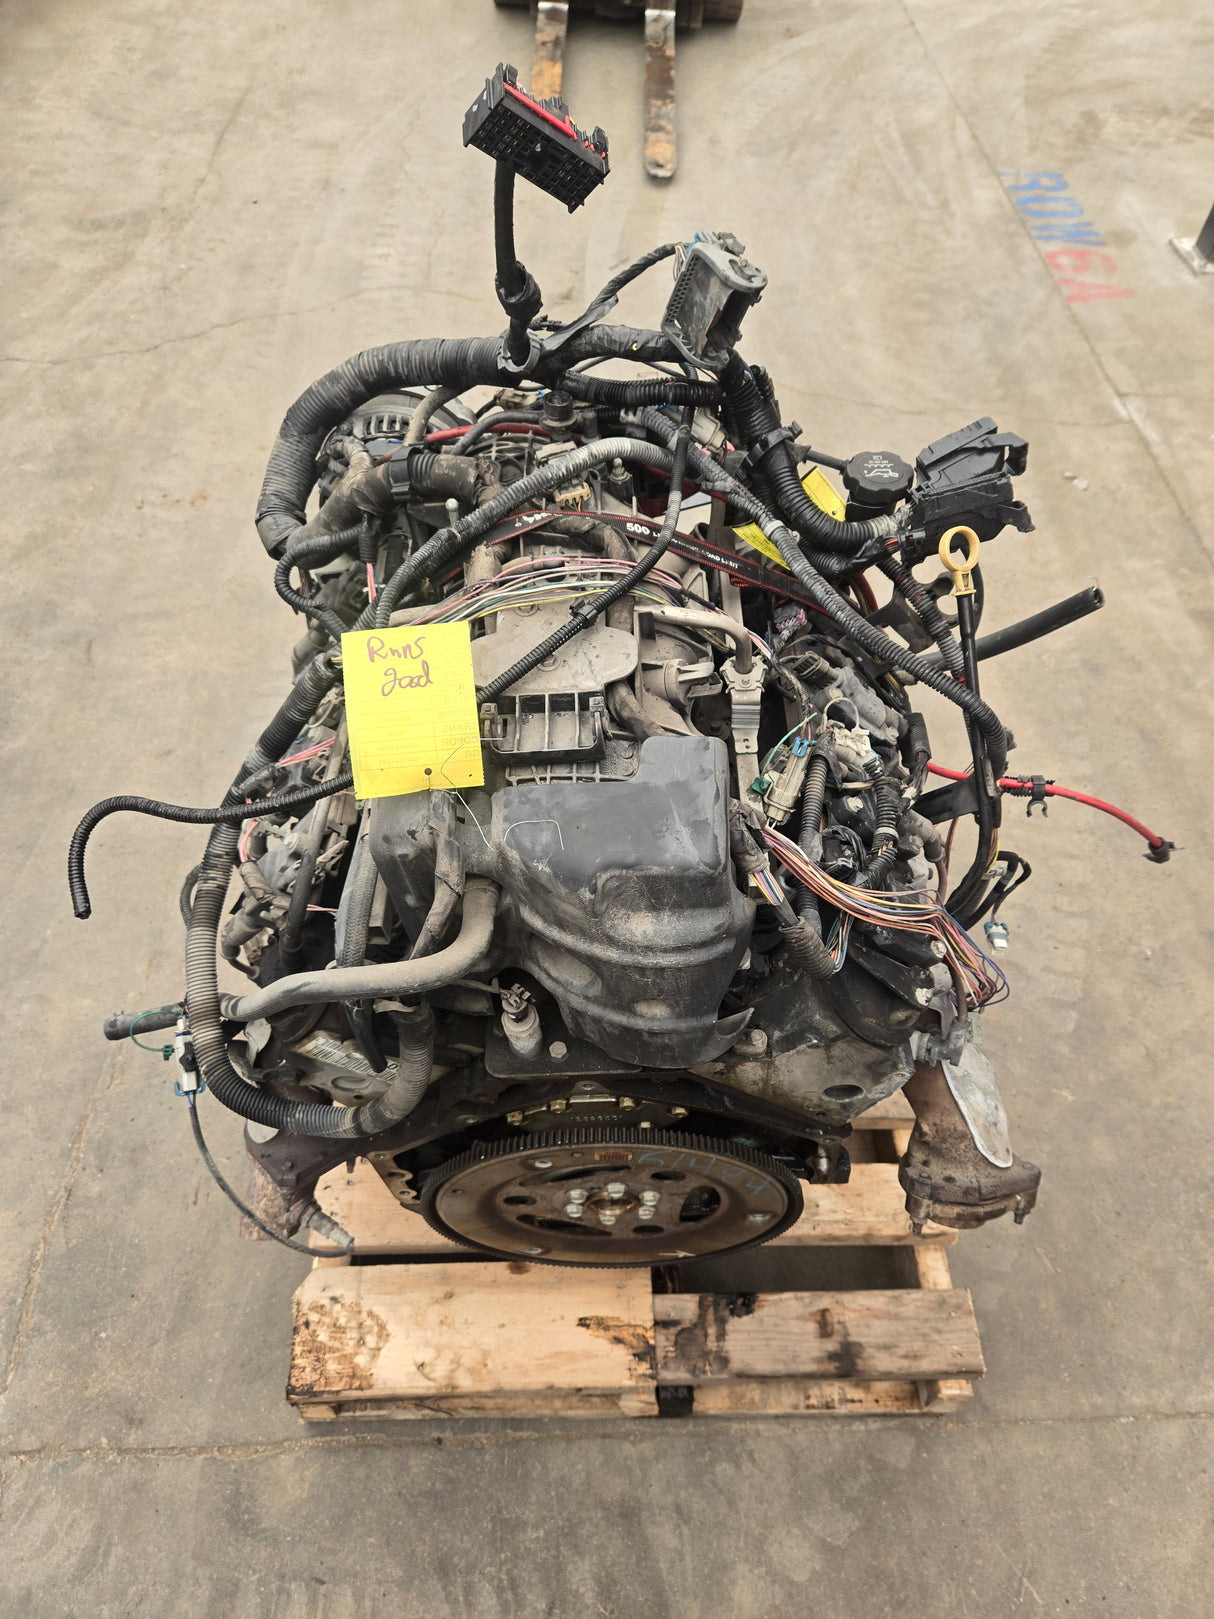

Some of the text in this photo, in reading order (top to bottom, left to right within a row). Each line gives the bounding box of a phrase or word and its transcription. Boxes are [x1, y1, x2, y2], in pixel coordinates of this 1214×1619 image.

[998, 172, 1136, 302] ROW 6A
[626, 522, 650, 535] 500
[381, 659, 434, 697] good
